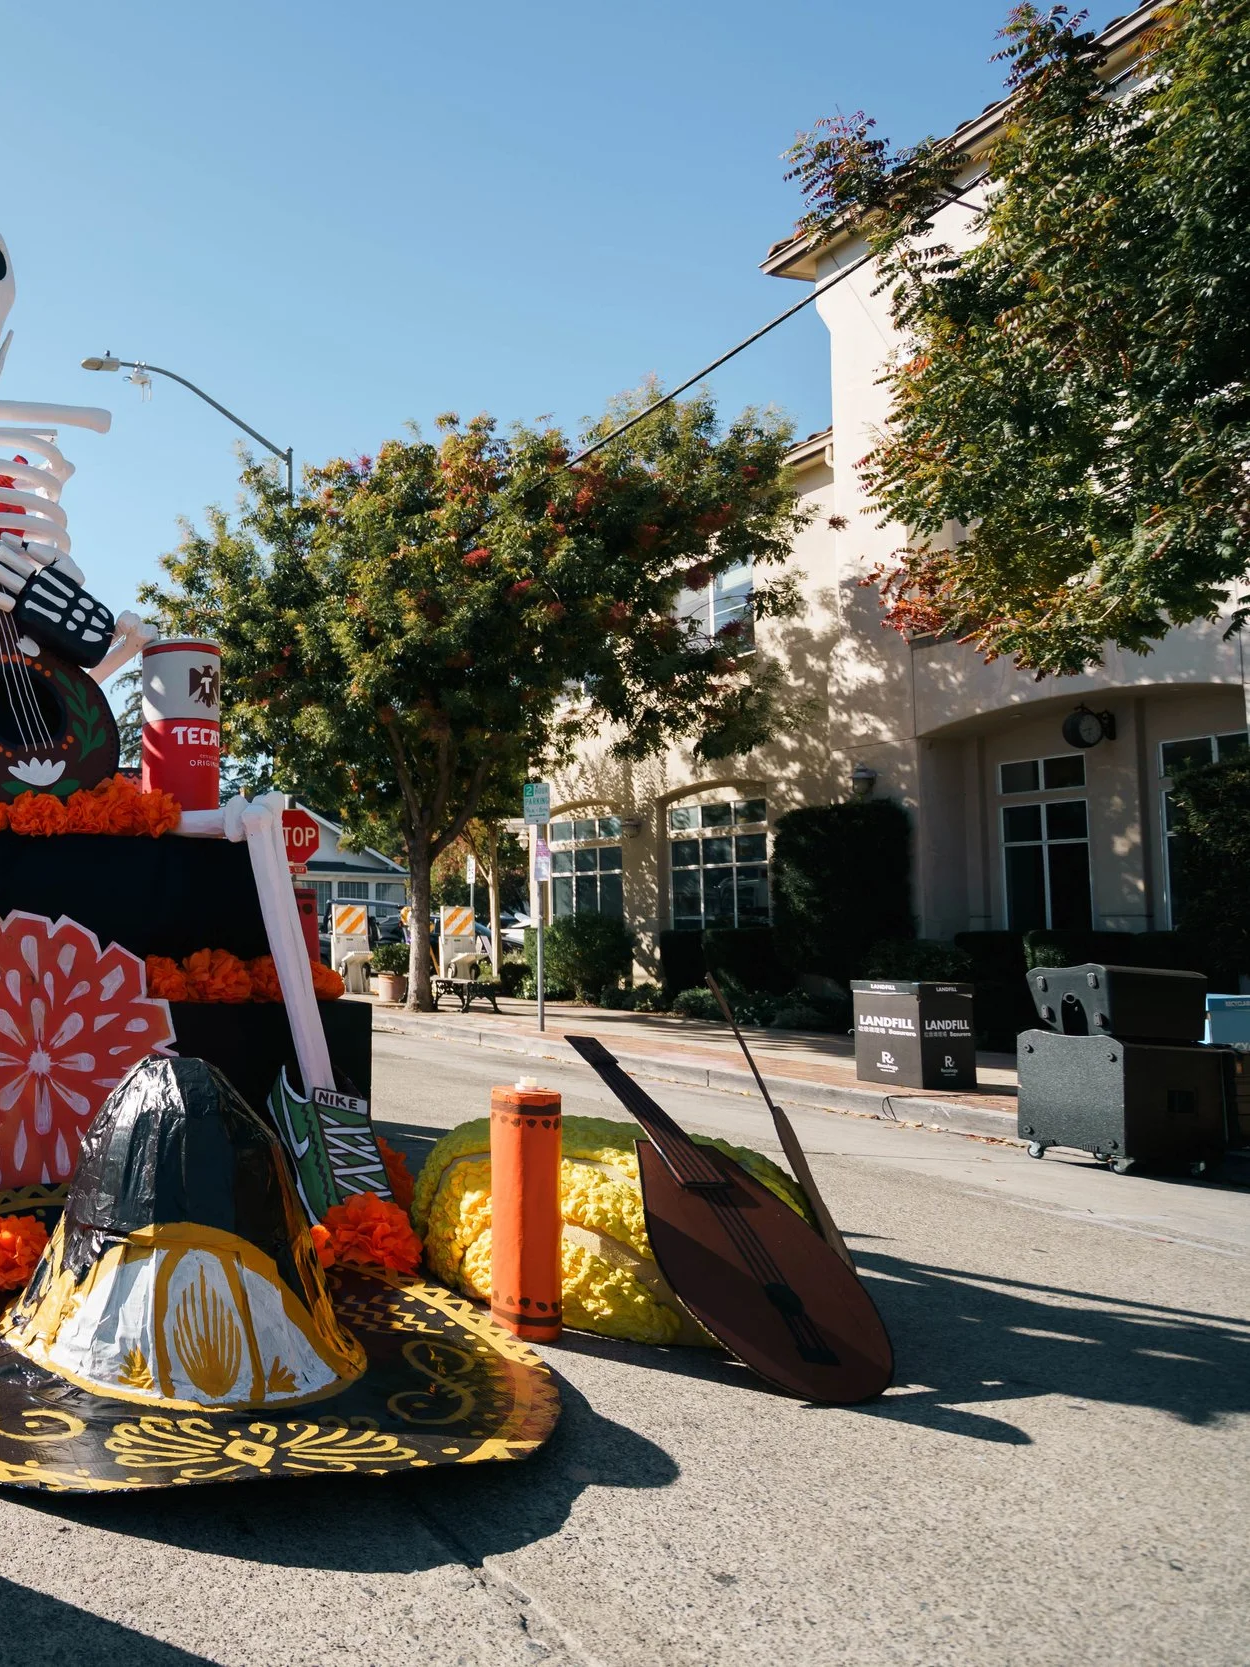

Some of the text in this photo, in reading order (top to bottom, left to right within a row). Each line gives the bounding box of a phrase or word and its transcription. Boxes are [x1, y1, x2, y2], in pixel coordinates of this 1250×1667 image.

[525, 785, 533, 796] 2
[282, 826, 316, 847] TOP
[859, 1014, 915, 1030] LANDFILL
[925, 1020, 969, 1030] LANDFILL
[318, 1091, 358, 1111] NIKE
